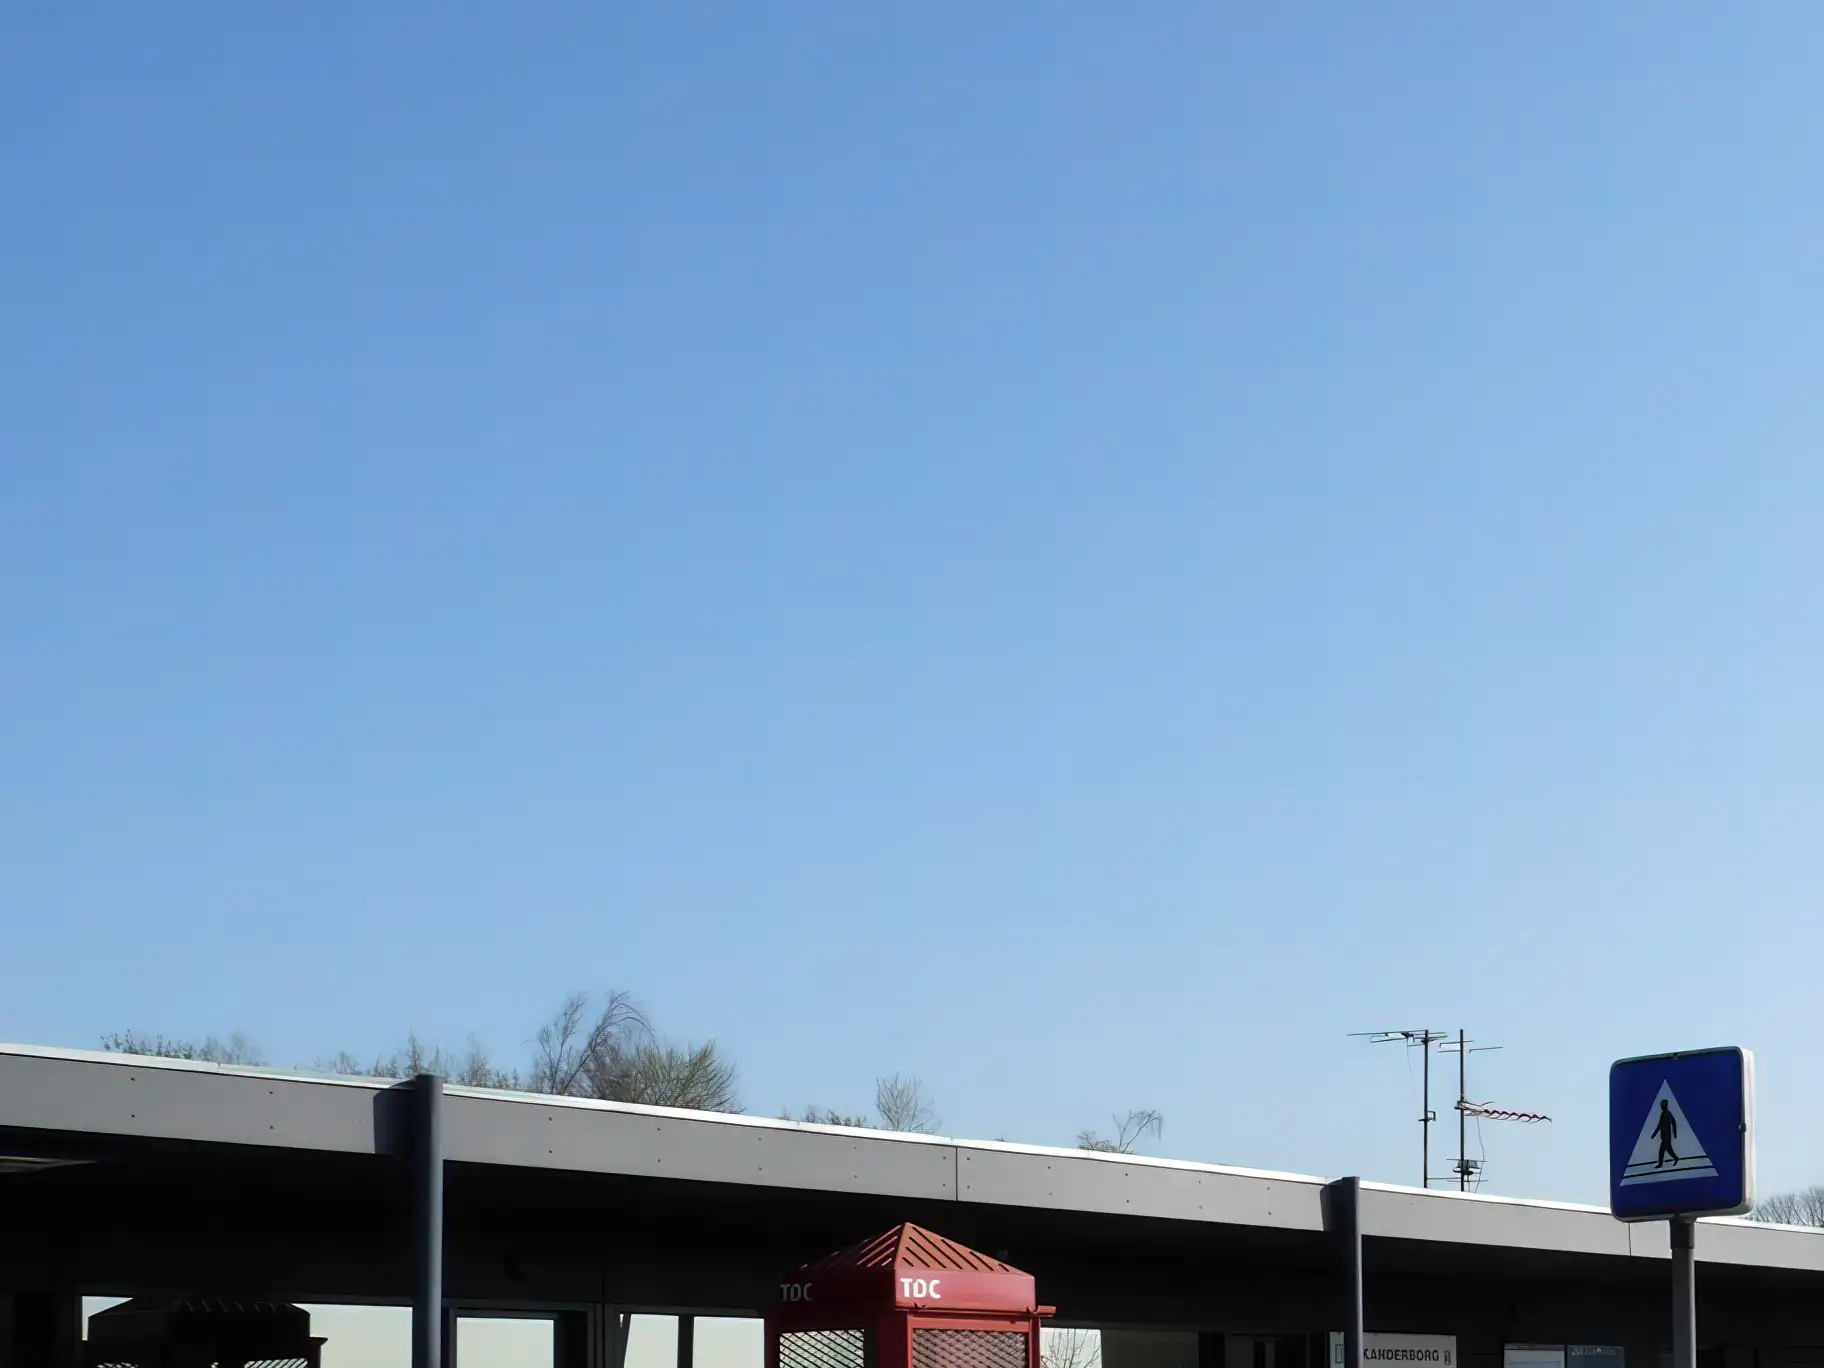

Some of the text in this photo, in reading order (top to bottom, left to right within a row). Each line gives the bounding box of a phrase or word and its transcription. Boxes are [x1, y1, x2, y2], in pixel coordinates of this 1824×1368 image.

[780, 1283, 812, 1301] TDC
[900, 1278, 941, 1299] TDC
[1363, 1348, 1440, 1361] KANDERBORG
